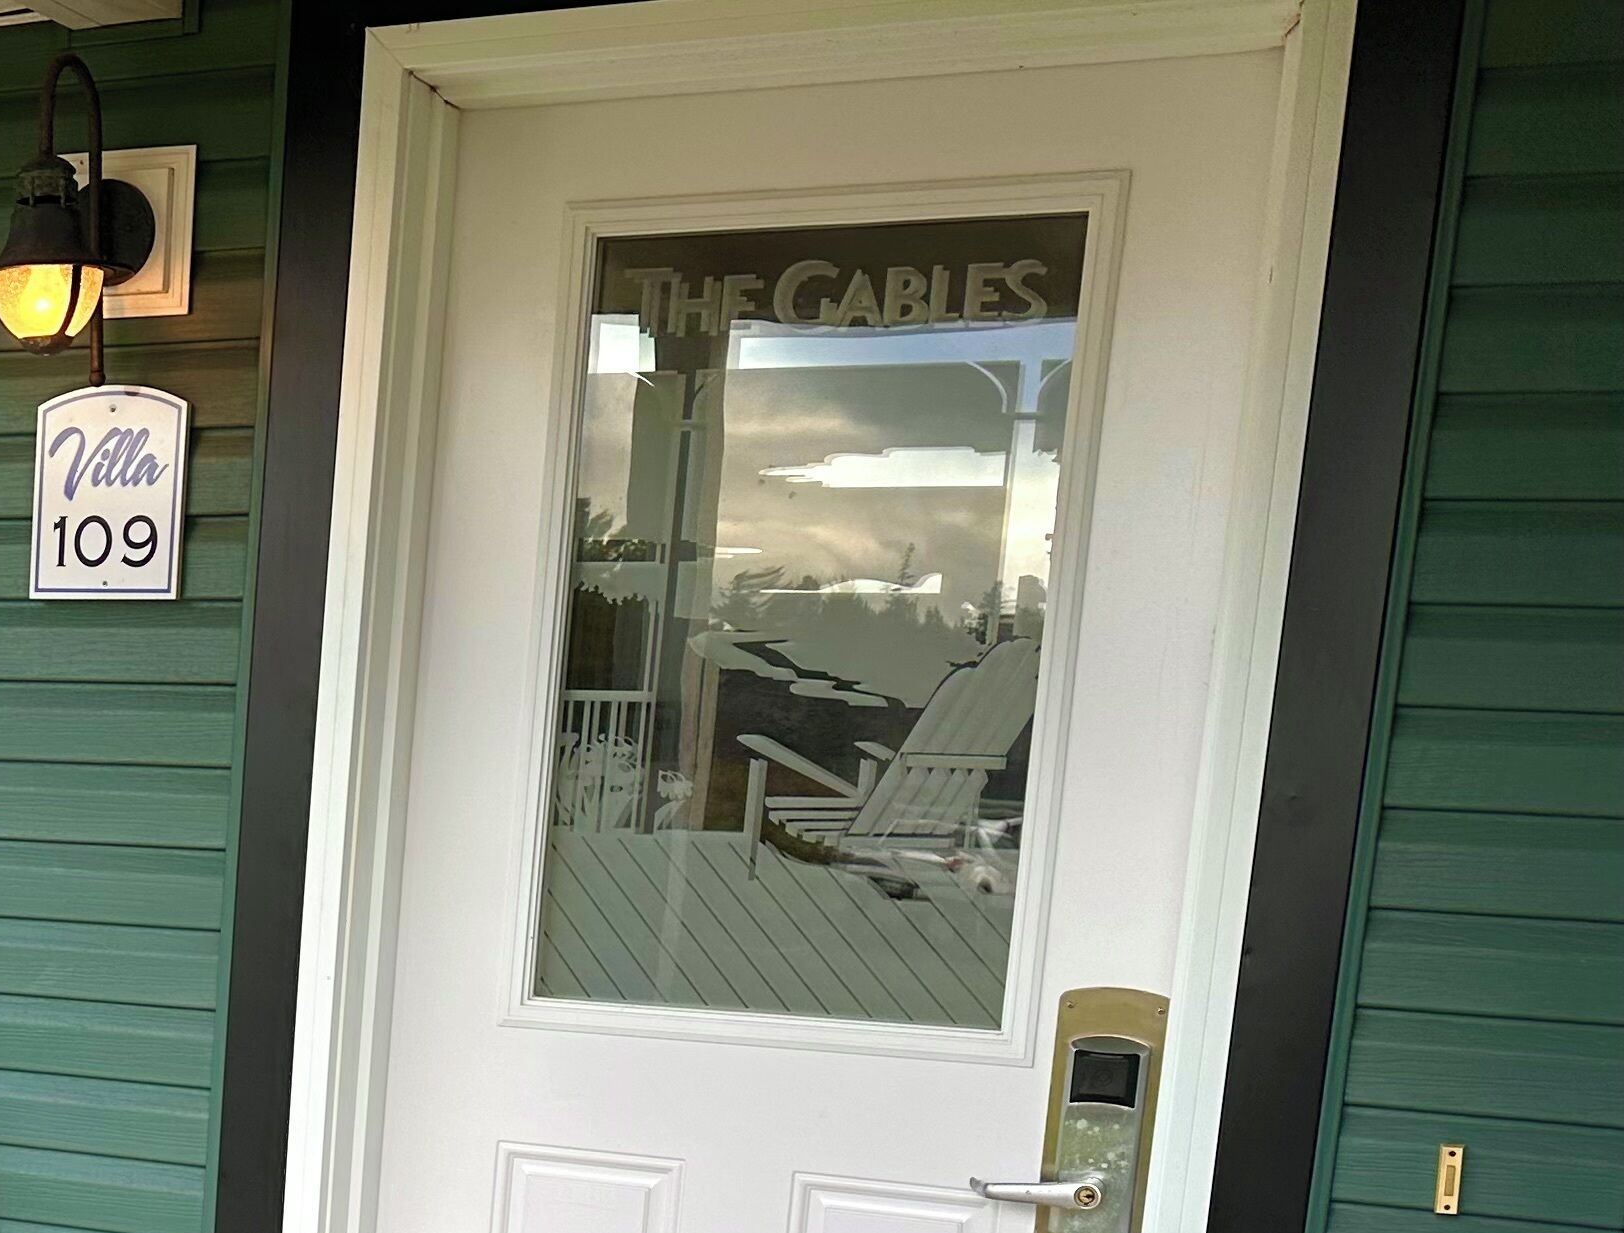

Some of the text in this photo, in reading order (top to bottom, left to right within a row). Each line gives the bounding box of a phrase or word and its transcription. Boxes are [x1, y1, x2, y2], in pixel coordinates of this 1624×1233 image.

[624, 259, 1048, 337] THE GABLES
[48, 426, 170, 502] Villa
[53, 514, 158, 568] 109
